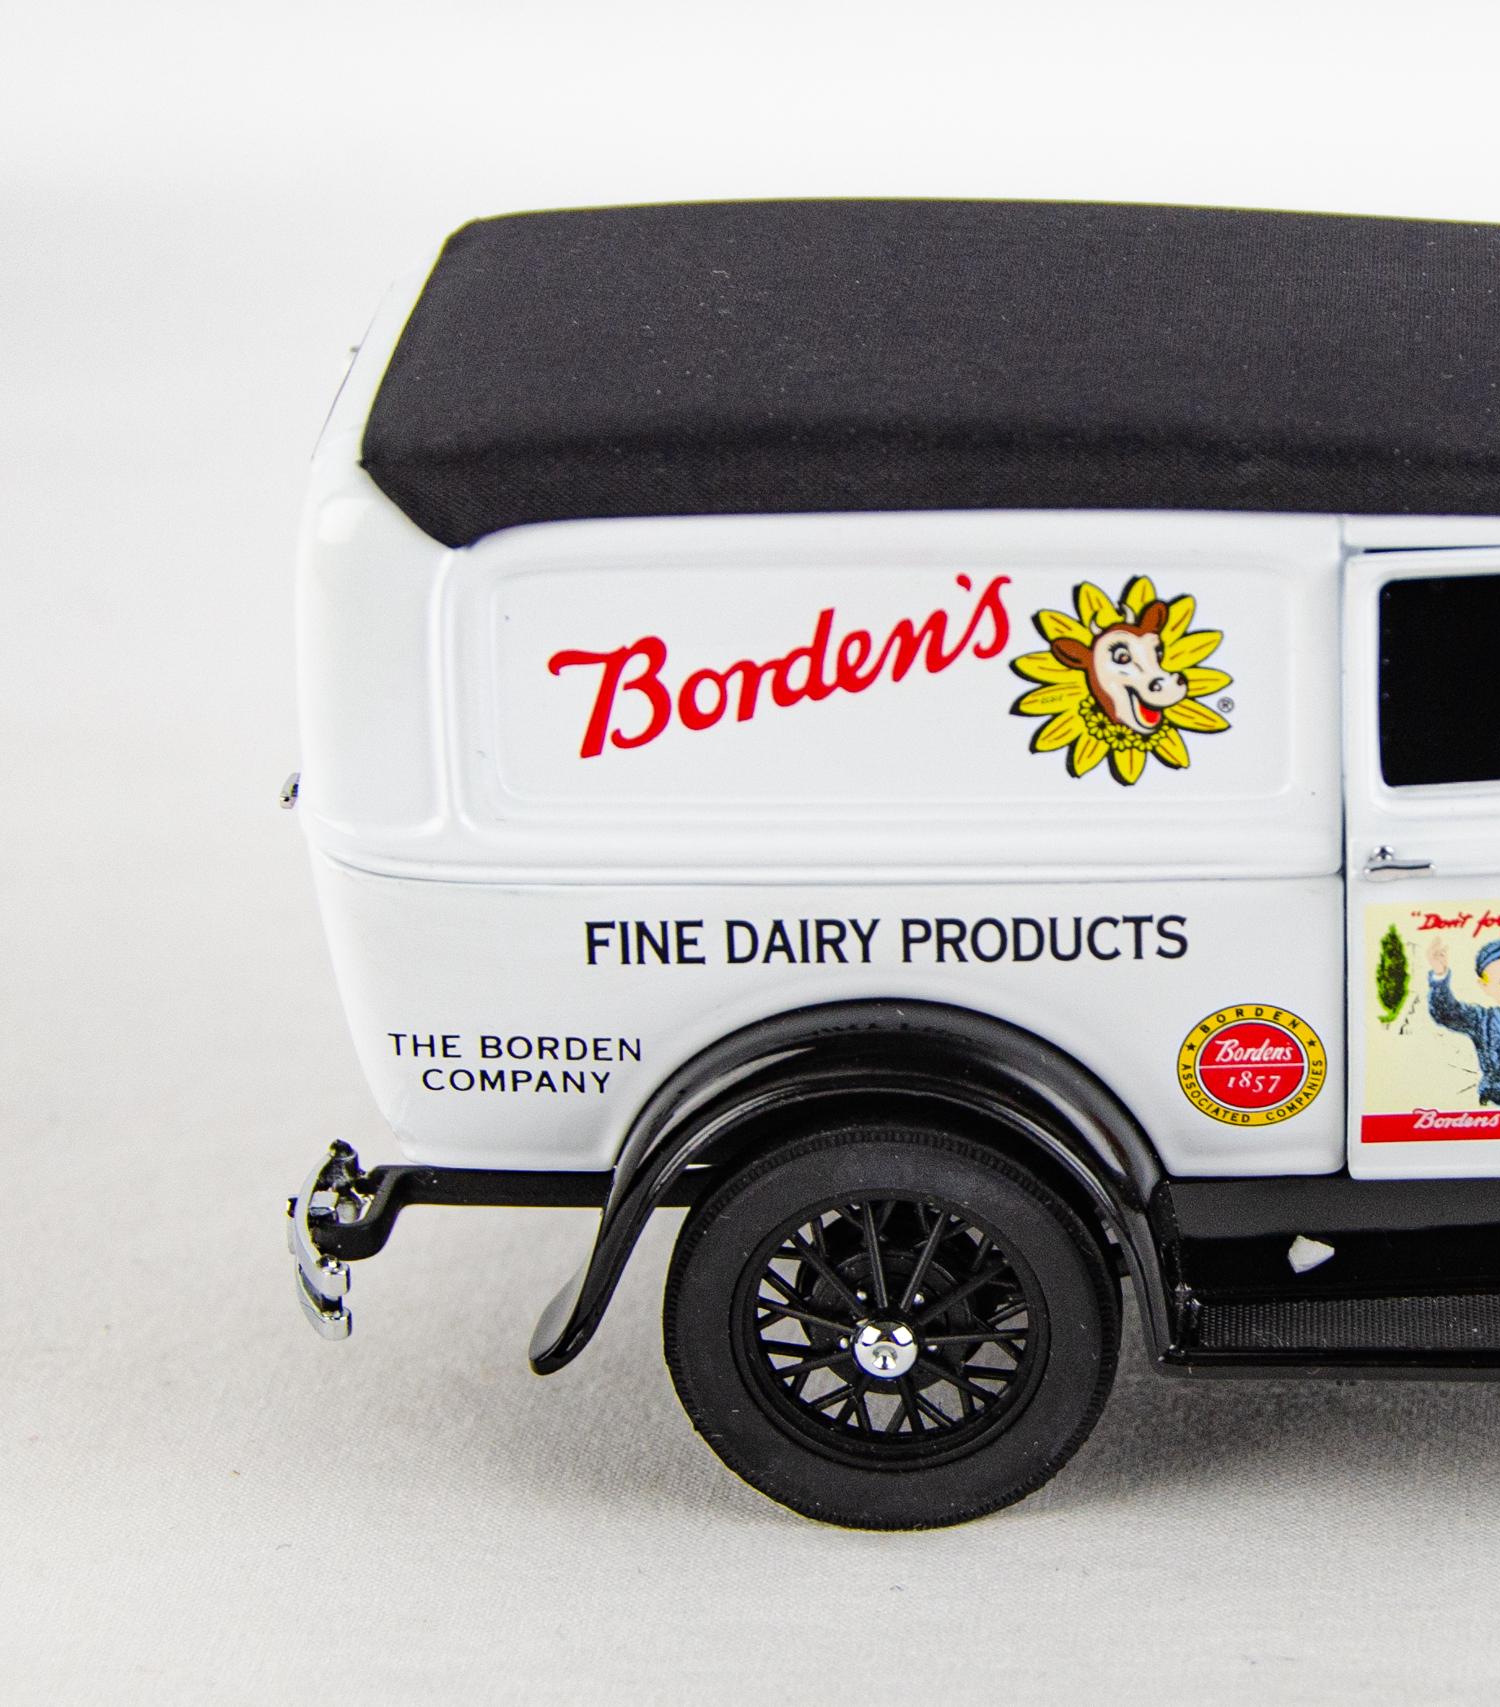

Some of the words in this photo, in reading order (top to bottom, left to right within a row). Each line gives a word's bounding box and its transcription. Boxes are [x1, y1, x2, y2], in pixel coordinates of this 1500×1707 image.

[548, 573, 1012, 759] Borden's
[585, 919, 706, 965] FINE
[725, 918, 880, 964] DAIRY
[901, 915, 1189, 963] PRODUCTS
[1199, 1006, 1300, 1033] BORDEN
[387, 1032, 462, 1058] THE
[480, 1034, 642, 1062] BORDEN
[422, 1068, 610, 1094] COMPANY
[1182, 1064, 1250, 1123] ASSOCIATED
[1265, 1059, 1324, 1121] COMPANIES
[1227, 1070, 1282, 1094] 1857
